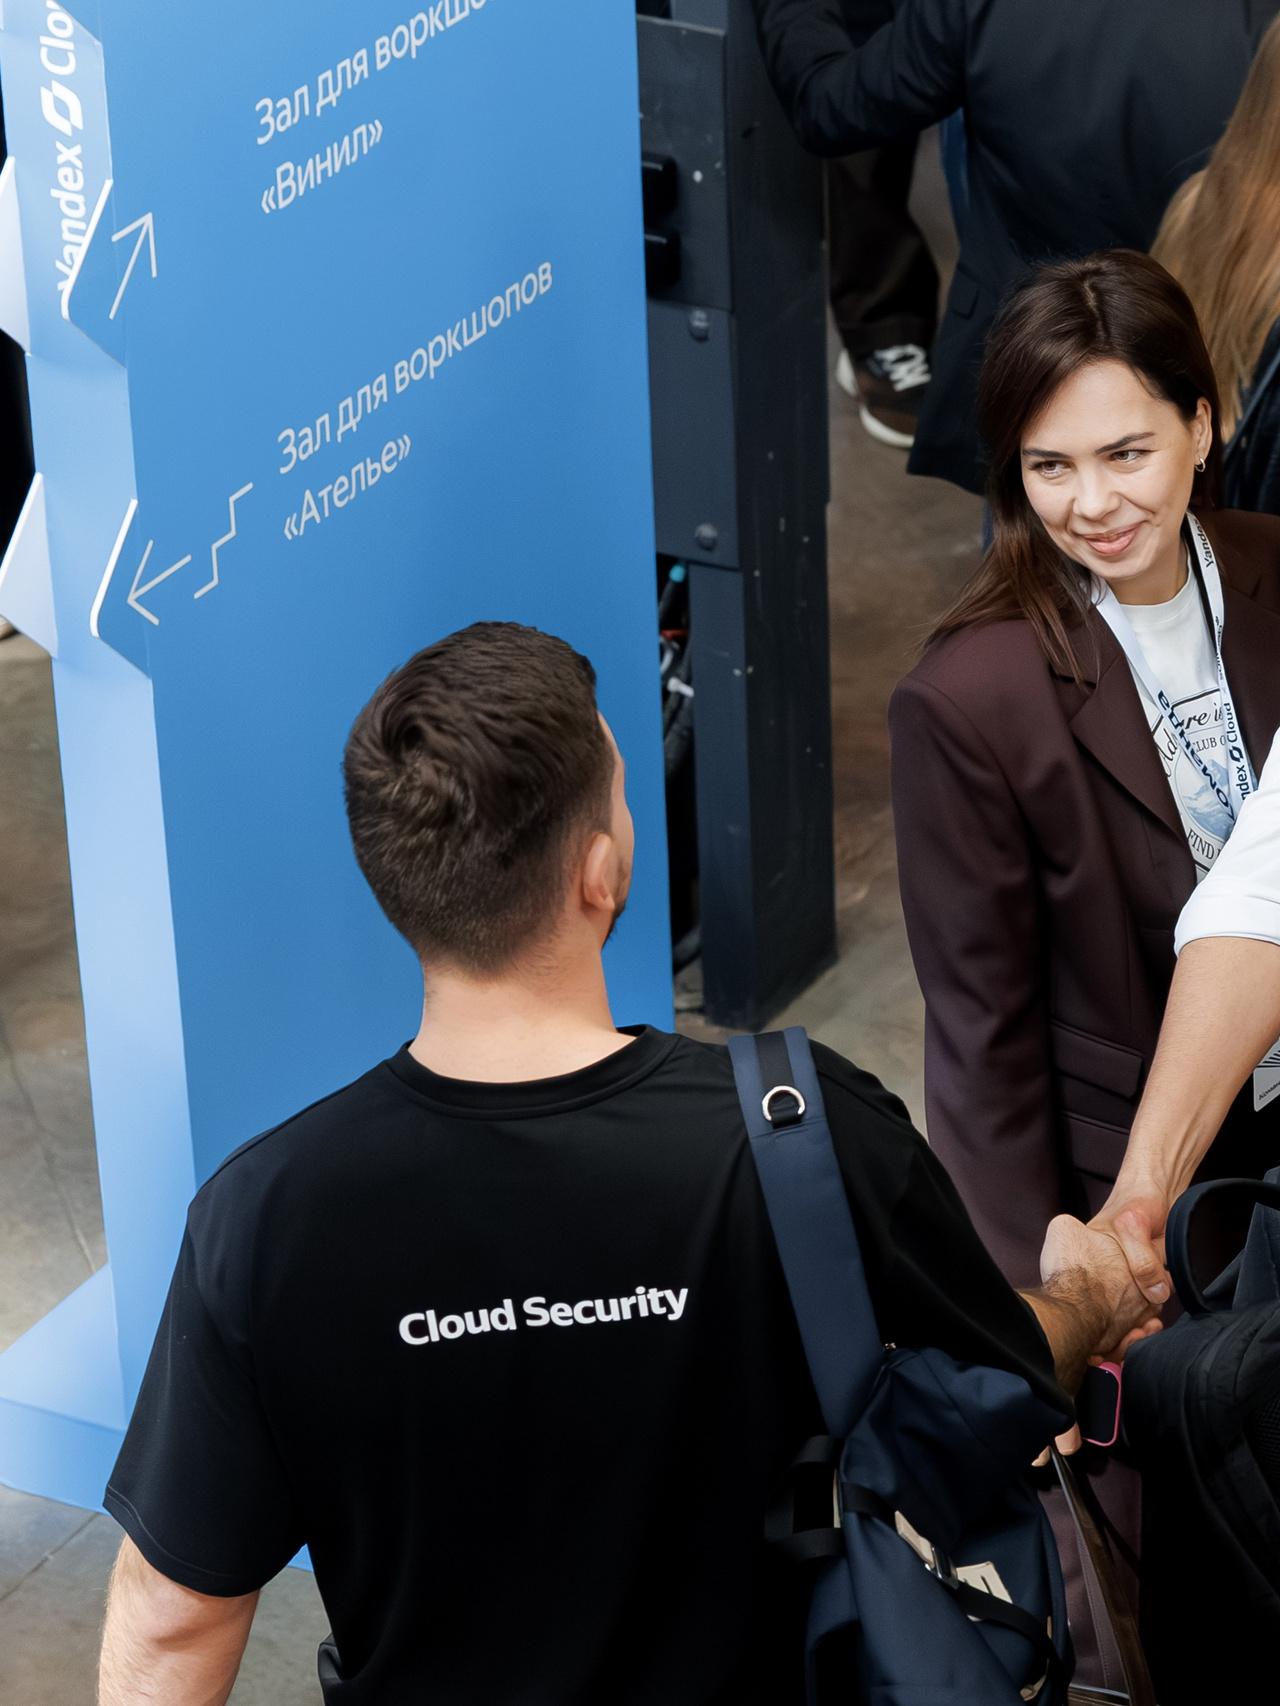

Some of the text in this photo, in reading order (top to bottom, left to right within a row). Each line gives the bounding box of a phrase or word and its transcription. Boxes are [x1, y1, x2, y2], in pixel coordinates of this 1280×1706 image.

[39, 0, 76, 76] Clo
[255, 0, 495, 146] Зал для воркш
[260, 119, 384, 214] «Винил»
[277, 261, 553, 475] Зал для воркшопов
[283, 434, 412, 540] «Ателье»
[1193, 738, 1217, 753] LUB
[1223, 702, 1251, 800] ndex Cloud
[1187, 827, 1215, 860] FIND
[398, 1285, 689, 1345] Cloud Security
